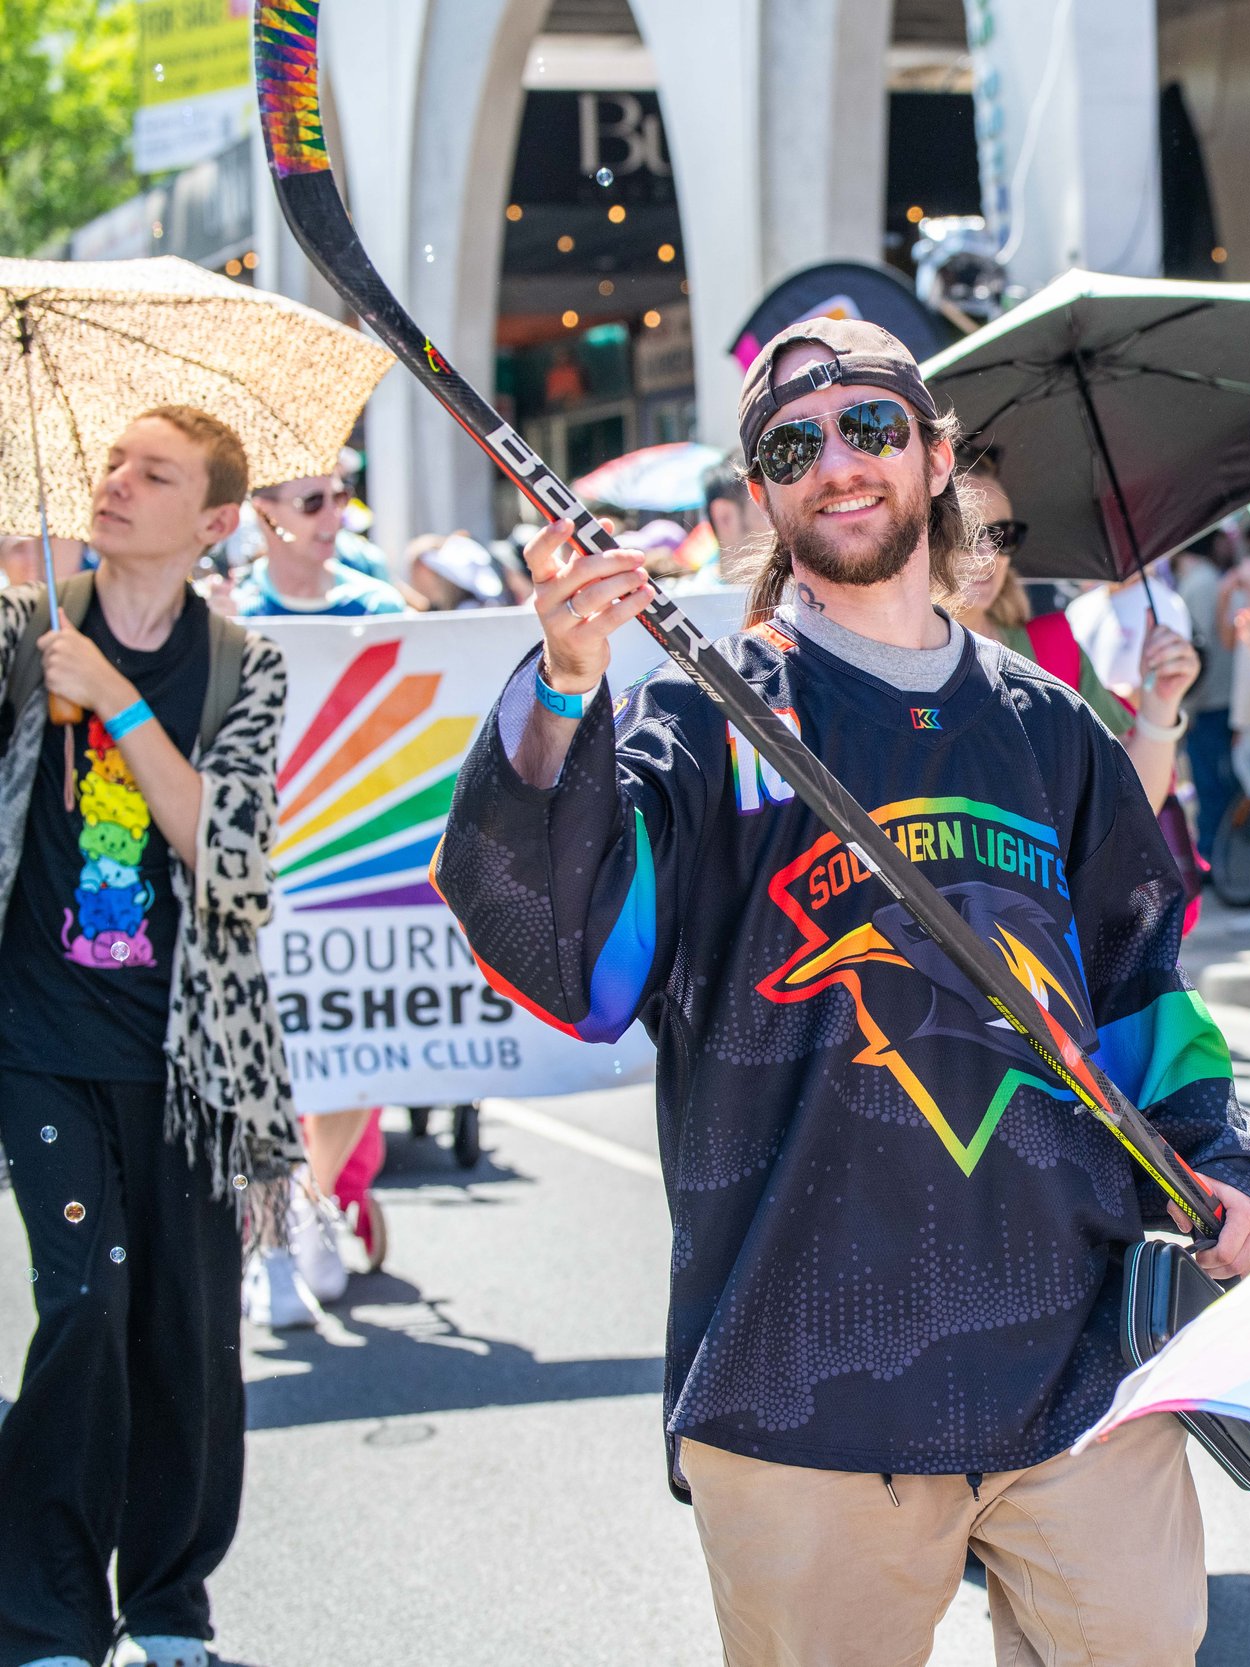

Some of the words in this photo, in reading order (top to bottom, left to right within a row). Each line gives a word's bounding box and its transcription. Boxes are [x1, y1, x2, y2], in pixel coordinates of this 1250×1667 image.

[808, 820, 965, 910] SOUHERN
[971, 823, 1070, 901] LIGHTS
[269, 924, 476, 978] BOURN
[422, 1037, 522, 1072] CLUB
